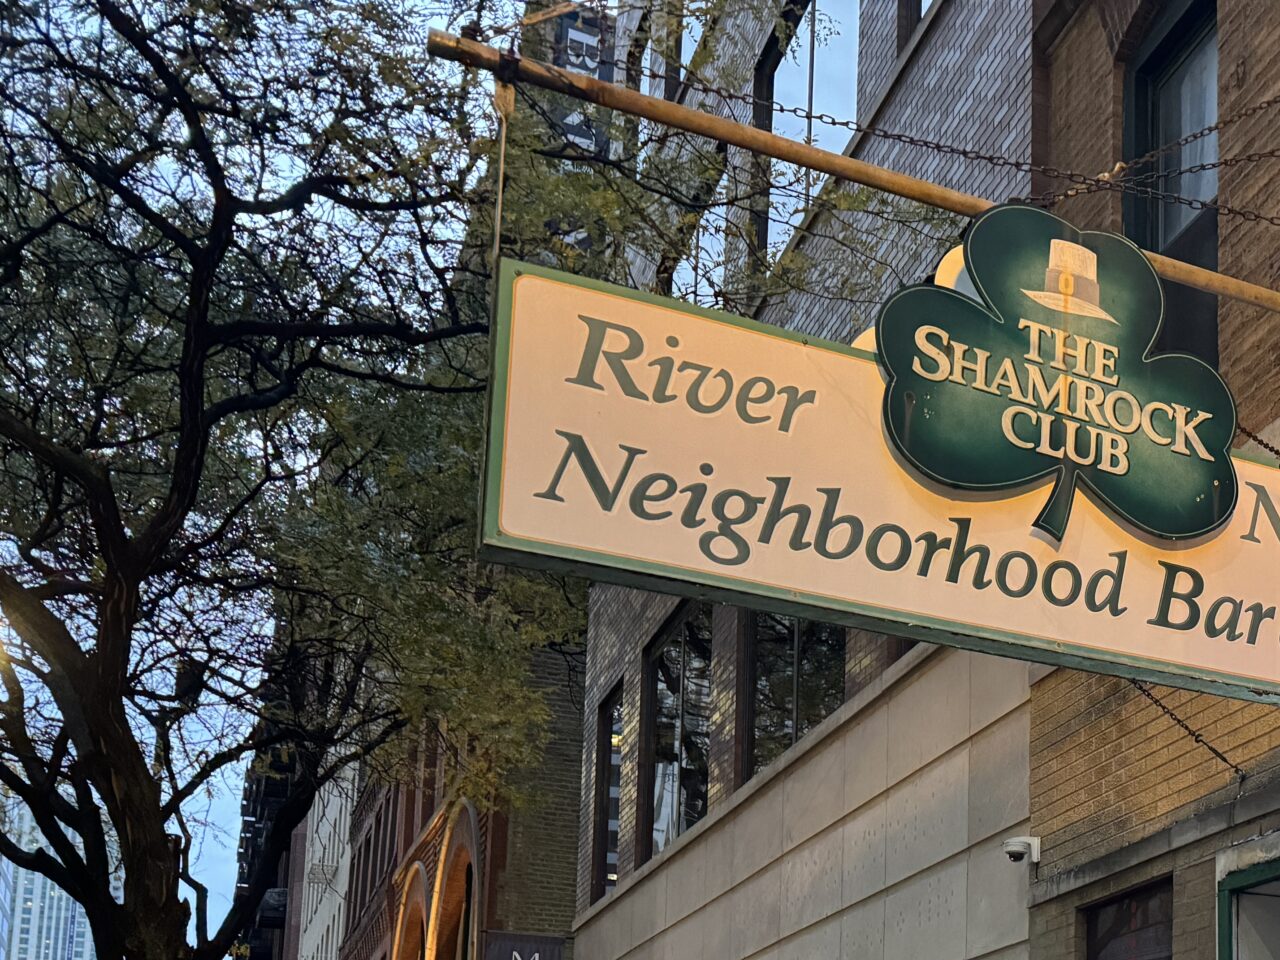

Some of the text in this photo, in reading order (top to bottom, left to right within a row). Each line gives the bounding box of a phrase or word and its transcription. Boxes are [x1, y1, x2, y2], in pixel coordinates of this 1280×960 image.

[565, 313, 816, 434] River
[911, 324, 1214, 464] SHAMROCK
[1018, 318, 1120, 383] THE
[1000, 400, 1131, 477] CLUB
[532, 429, 1128, 618] Neighborhood
[1145, 560, 1278, 648] Bar
